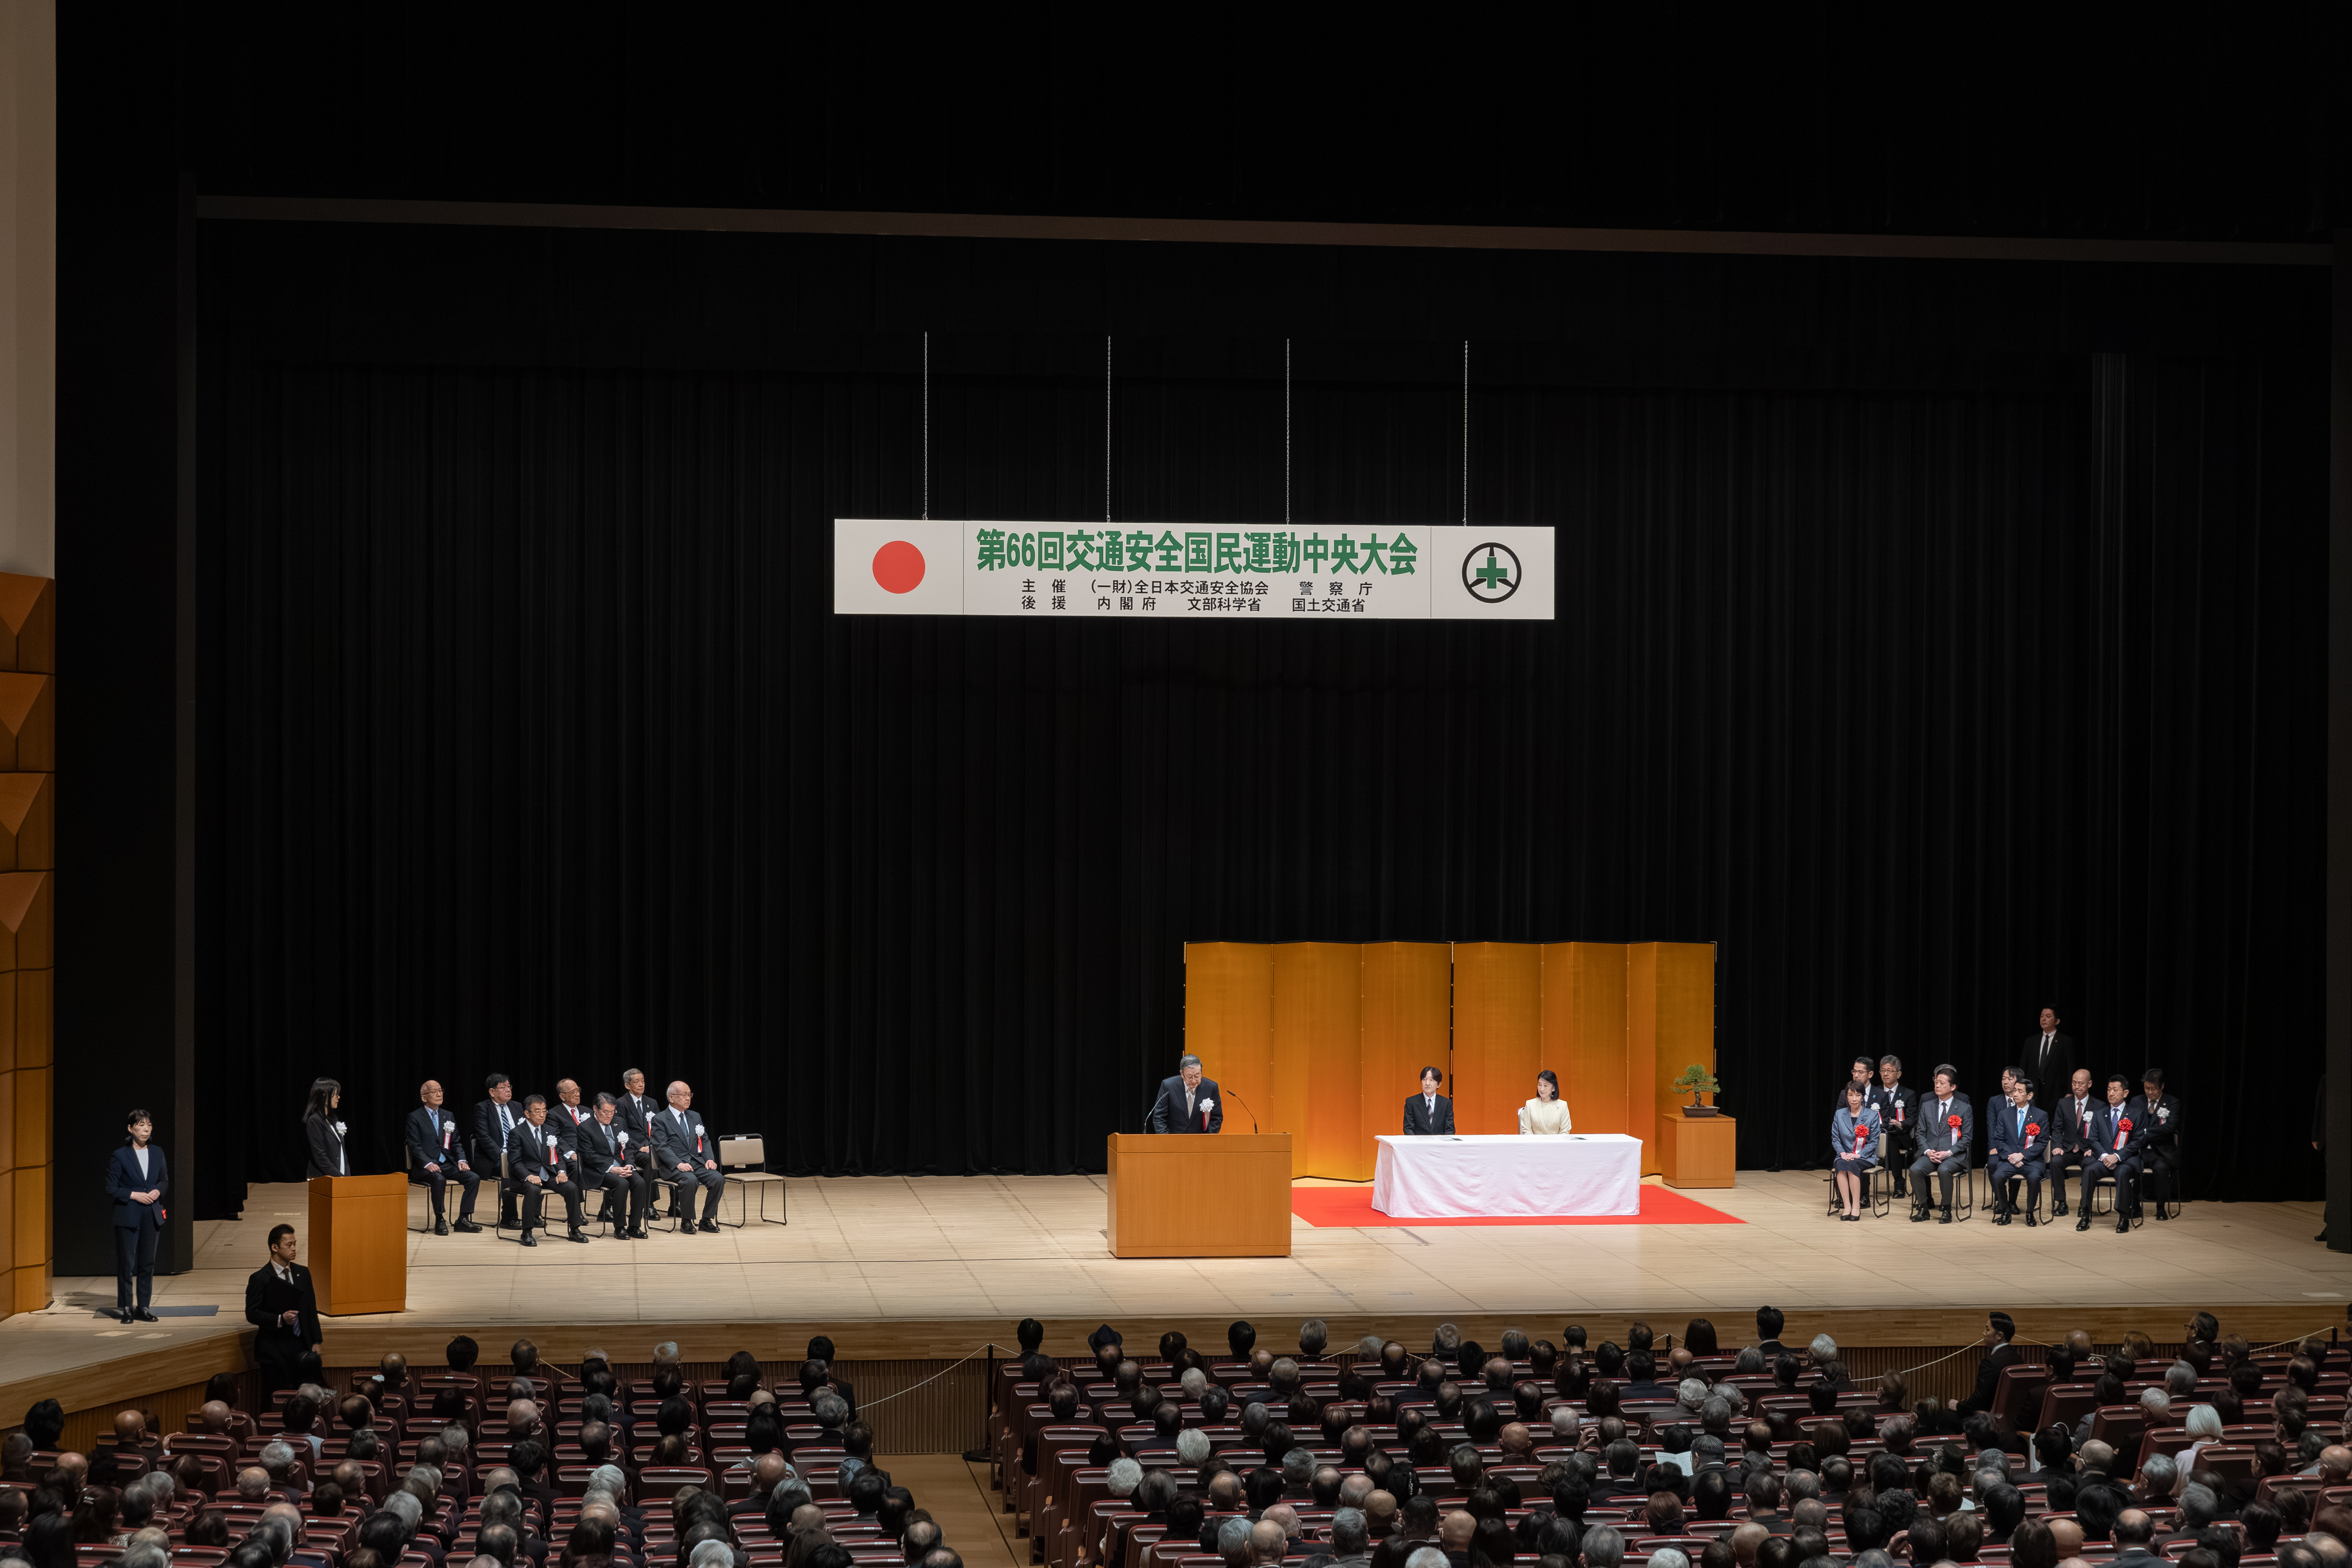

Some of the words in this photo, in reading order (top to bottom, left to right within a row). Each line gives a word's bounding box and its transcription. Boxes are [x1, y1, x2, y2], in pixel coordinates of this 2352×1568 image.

[977, 528, 1418, 575] 第66回交通安全国民運動中央大会
[1091, 579, 1269, 595] (一財)全日本交通安全協会
[1098, 596, 1156, 611] 内閣府
[1187, 596, 1261, 612] 文部科学省
[1292, 598, 1365, 613] 国土交通省
